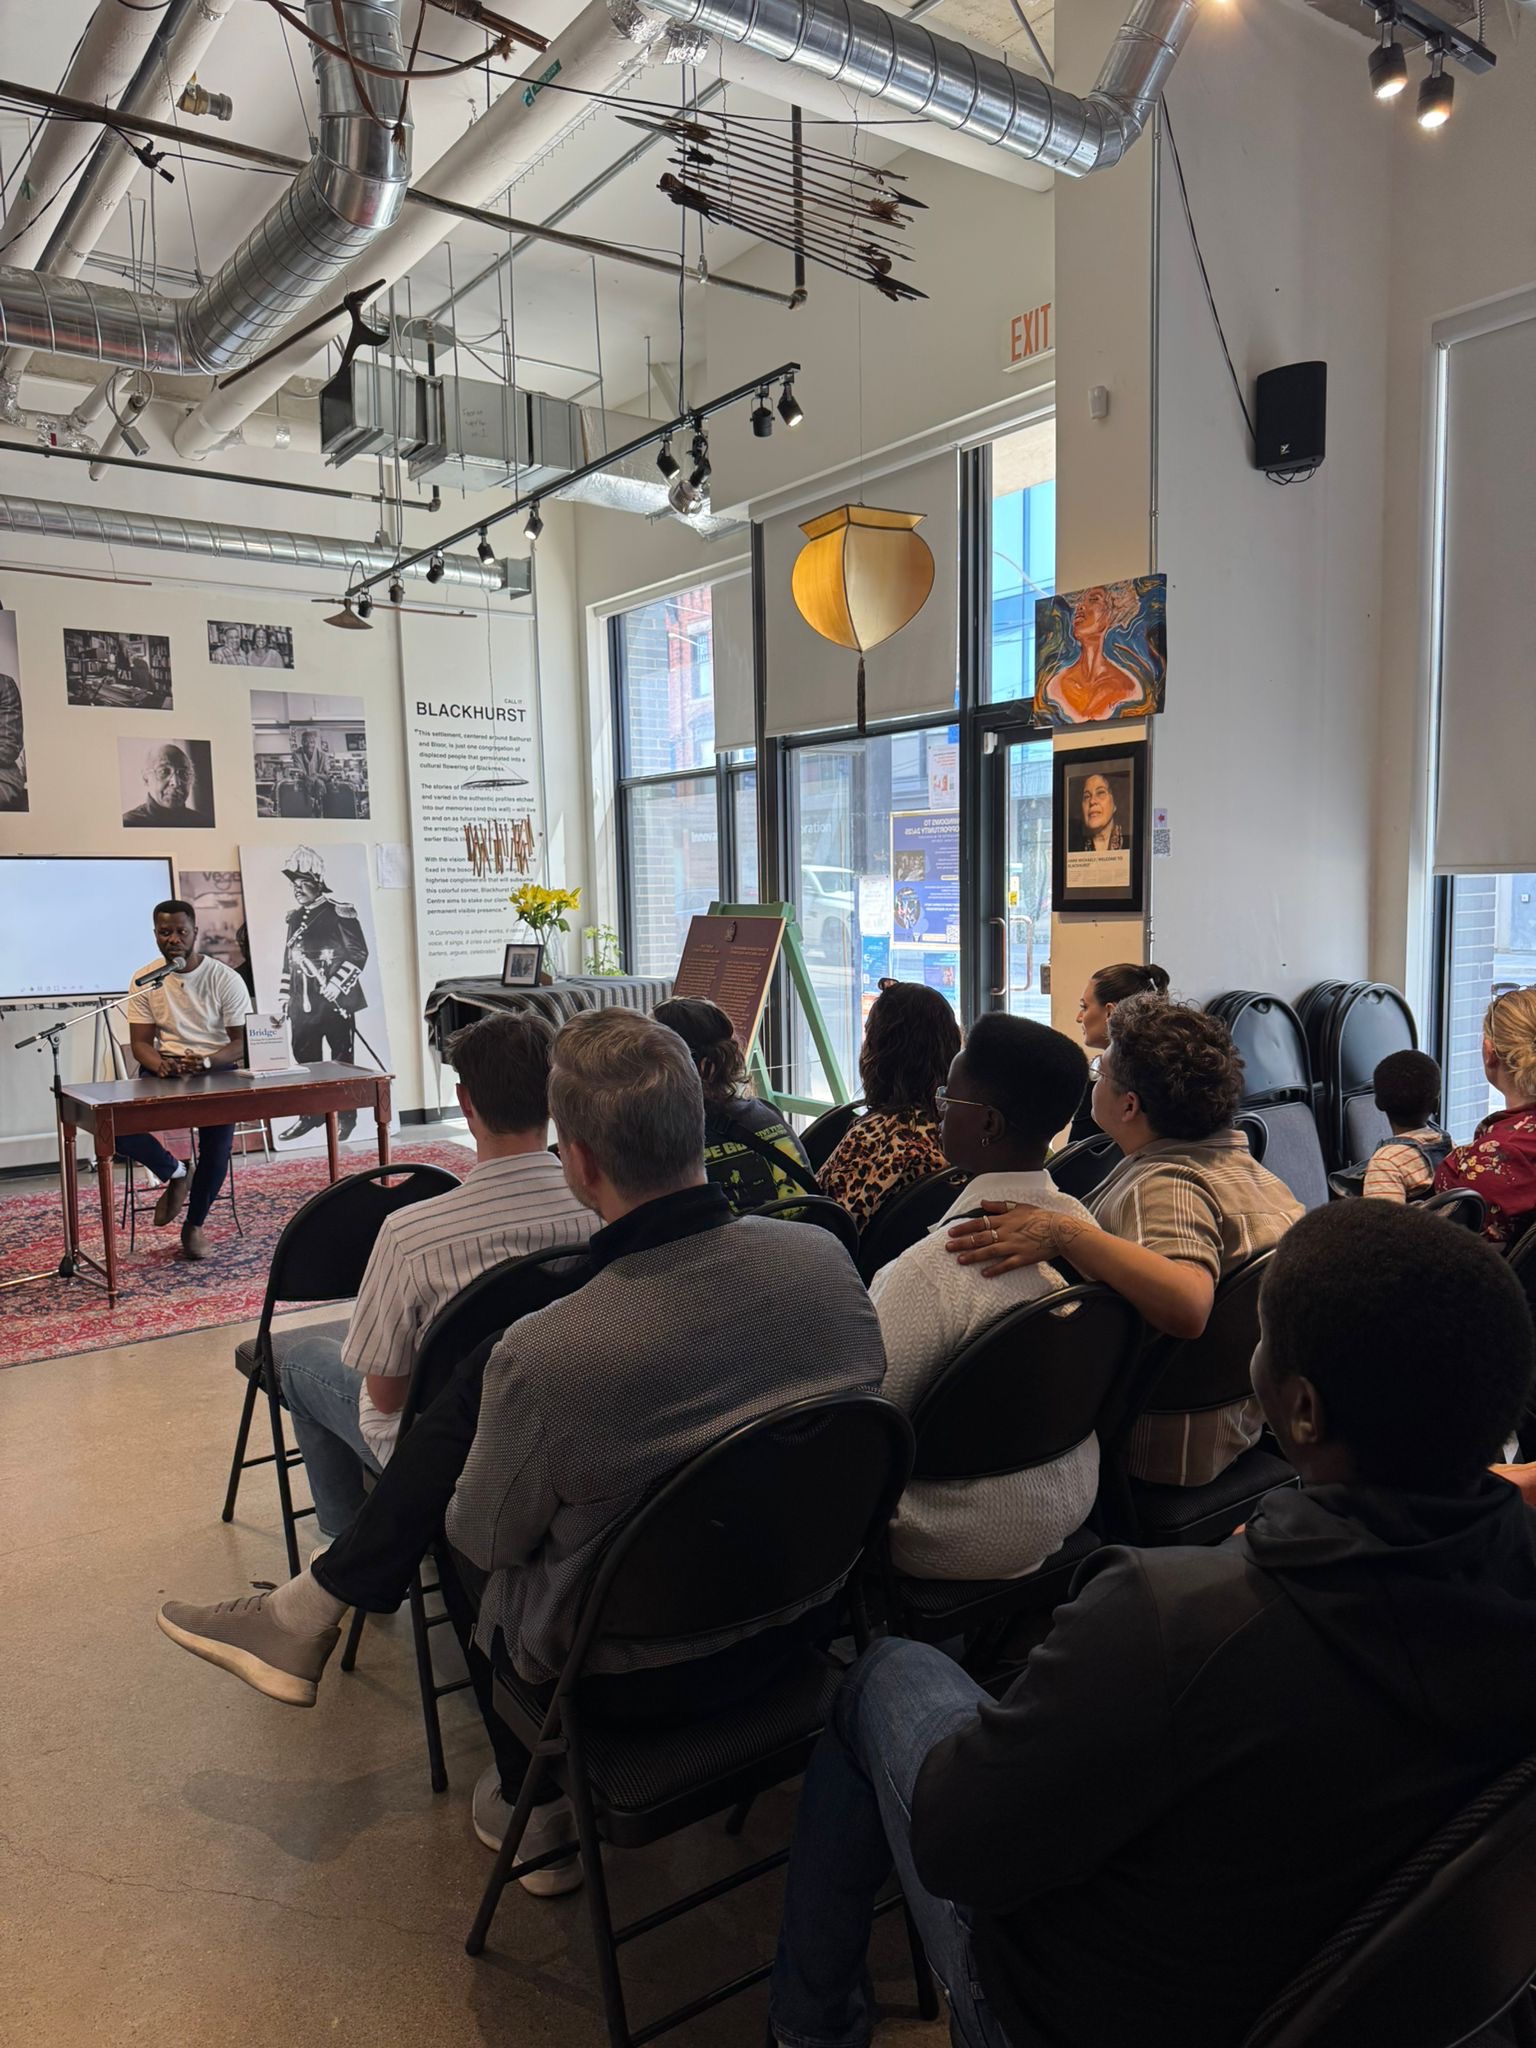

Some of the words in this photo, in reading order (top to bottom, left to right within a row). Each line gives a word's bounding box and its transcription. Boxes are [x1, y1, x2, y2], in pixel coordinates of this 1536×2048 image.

[1011, 302, 1051, 361] EXIT
[416, 701, 526, 722] BLACKHURST
[432, 731, 463, 739] settlement,
[442, 763, 468, 771] flowering
[691, 831, 718, 843] Innova
[426, 877, 449, 885] highrise
[435, 929, 464, 937] Community
[249, 1028, 278, 1038] Bridge
